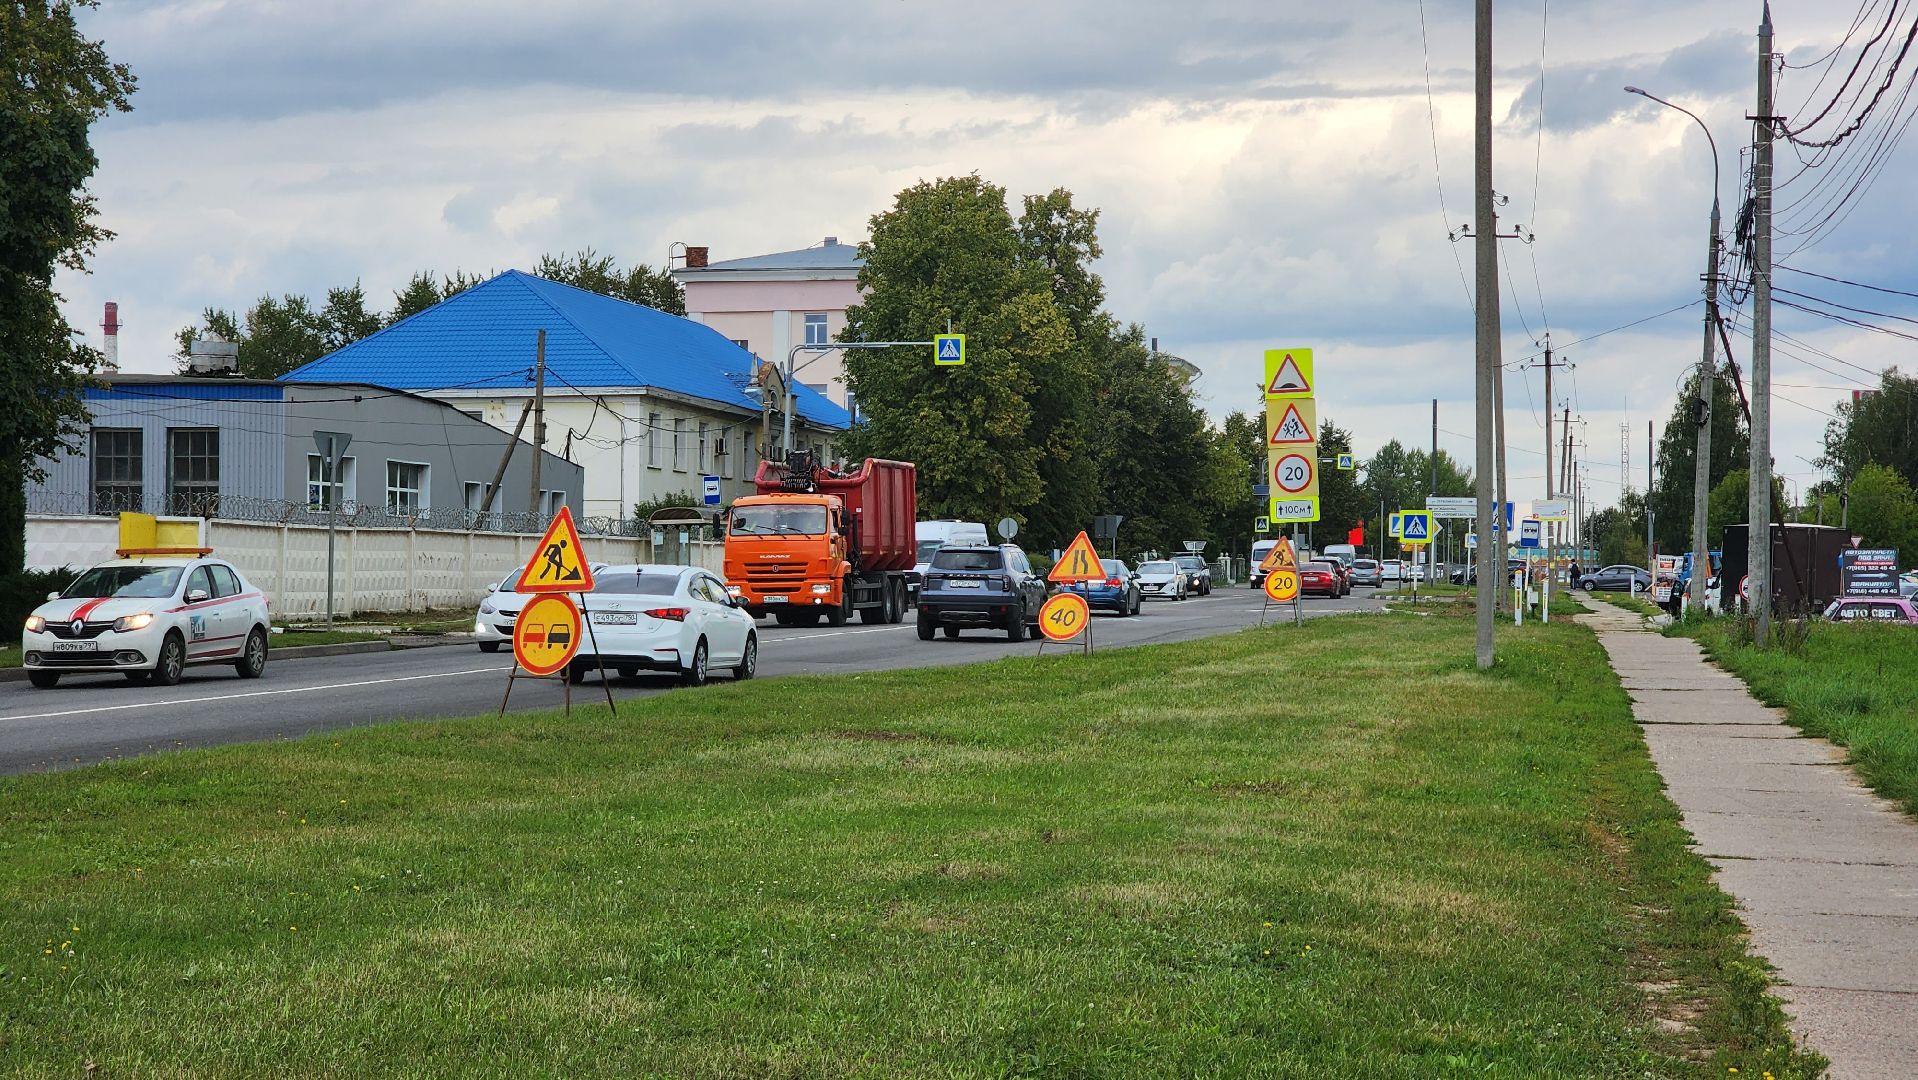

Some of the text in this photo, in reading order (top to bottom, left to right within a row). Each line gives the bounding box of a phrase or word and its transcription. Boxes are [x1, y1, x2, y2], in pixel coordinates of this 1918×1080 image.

[1285, 466, 1304, 481] 20
[1273, 576, 1293, 591] 20
[1050, 608, 1076, 627] 40
[1841, 609, 1868, 618] АВТО
[1871, 609, 1897, 618] СВЕТ
